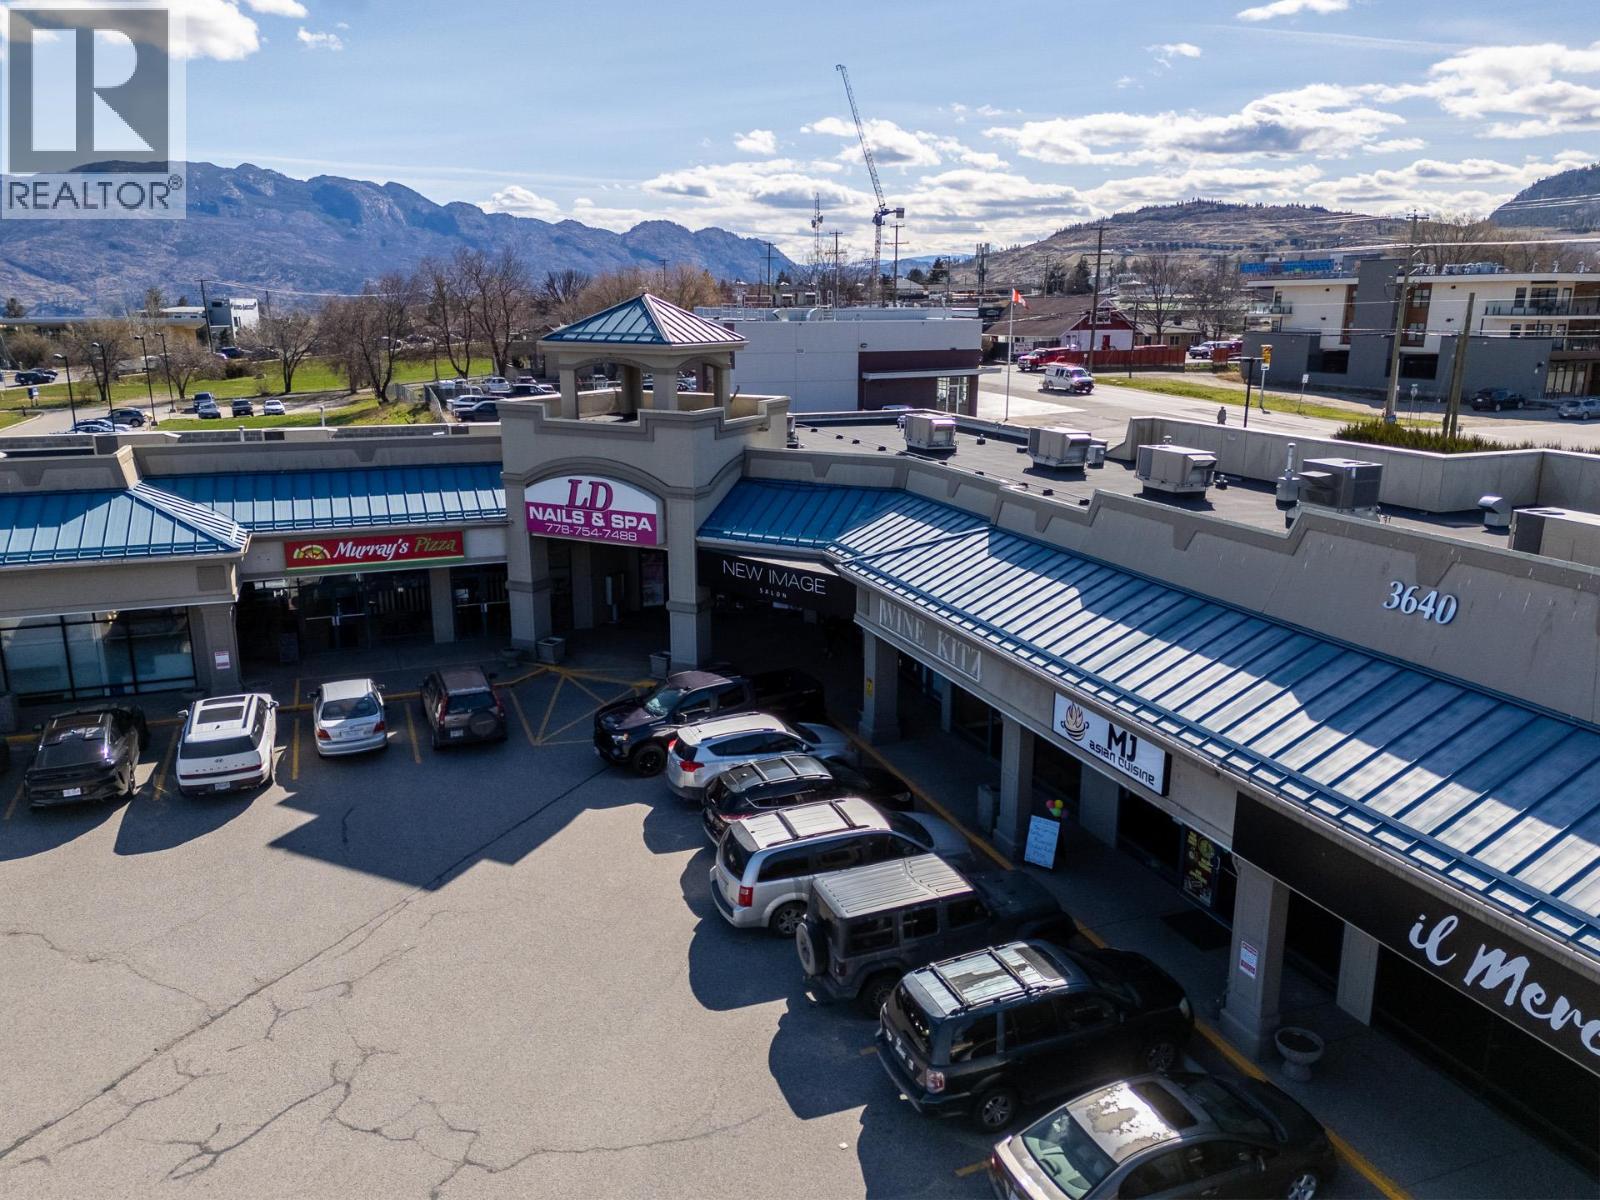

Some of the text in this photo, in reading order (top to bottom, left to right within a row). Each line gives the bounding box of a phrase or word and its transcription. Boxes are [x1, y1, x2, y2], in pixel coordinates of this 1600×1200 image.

[565, 478, 614, 512] LD
[529, 506, 653, 532] NAILS & SPA
[545, 523, 638, 542] 778-754-7488
[333, 536, 457, 561] Murray's Pizza
[723, 560, 827, 595] NEW IMAGE
[759, 587, 788, 599] SALON
[1382, 580, 1458, 625] 3640
[1107, 722, 1138, 762] MJ
[1089, 739, 1155, 786] asian cuisine
[1409, 914, 1459, 967] il
